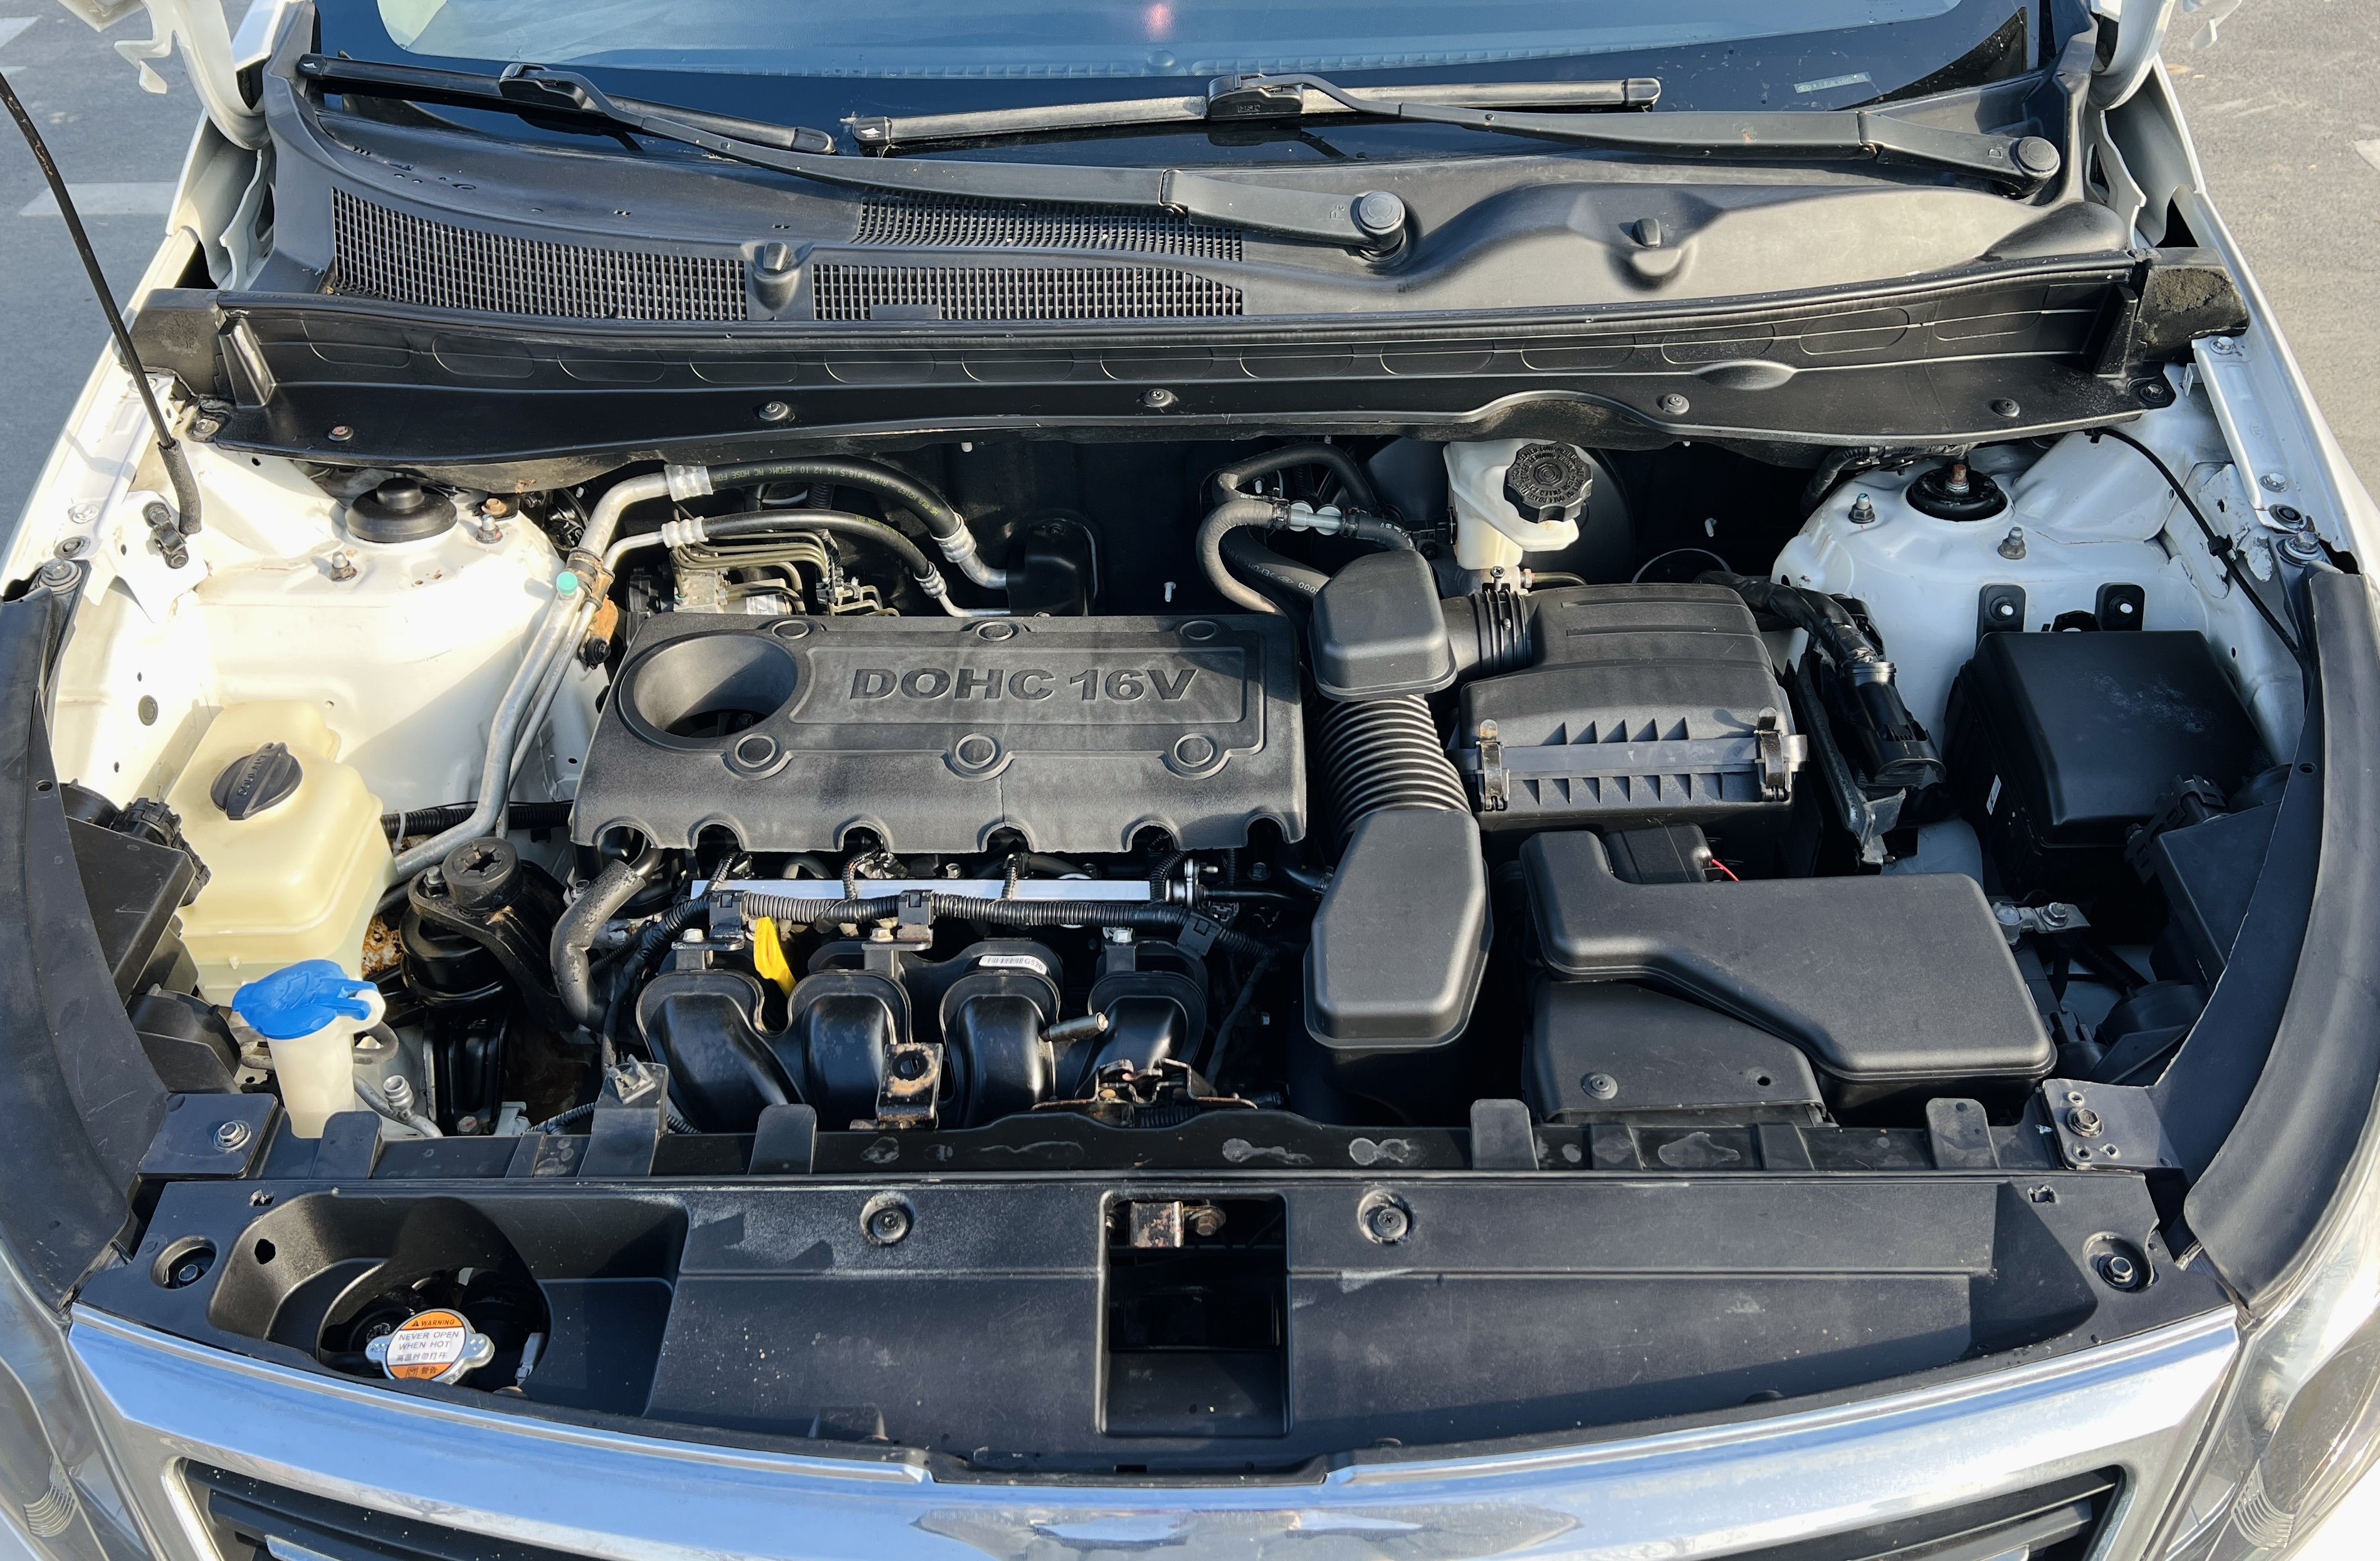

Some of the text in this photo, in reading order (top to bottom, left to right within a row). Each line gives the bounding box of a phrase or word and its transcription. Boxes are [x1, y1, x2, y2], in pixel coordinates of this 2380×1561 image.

[714, 473, 728, 482] FOR
[731, 470, 750, 479] HOSE
[850, 668, 1198, 702] DOHC 16V
[1024, 958, 1043, 970] G520
[399, 1332, 429, 1341] NEVER
[399, 1342, 426, 1350] WHEN
